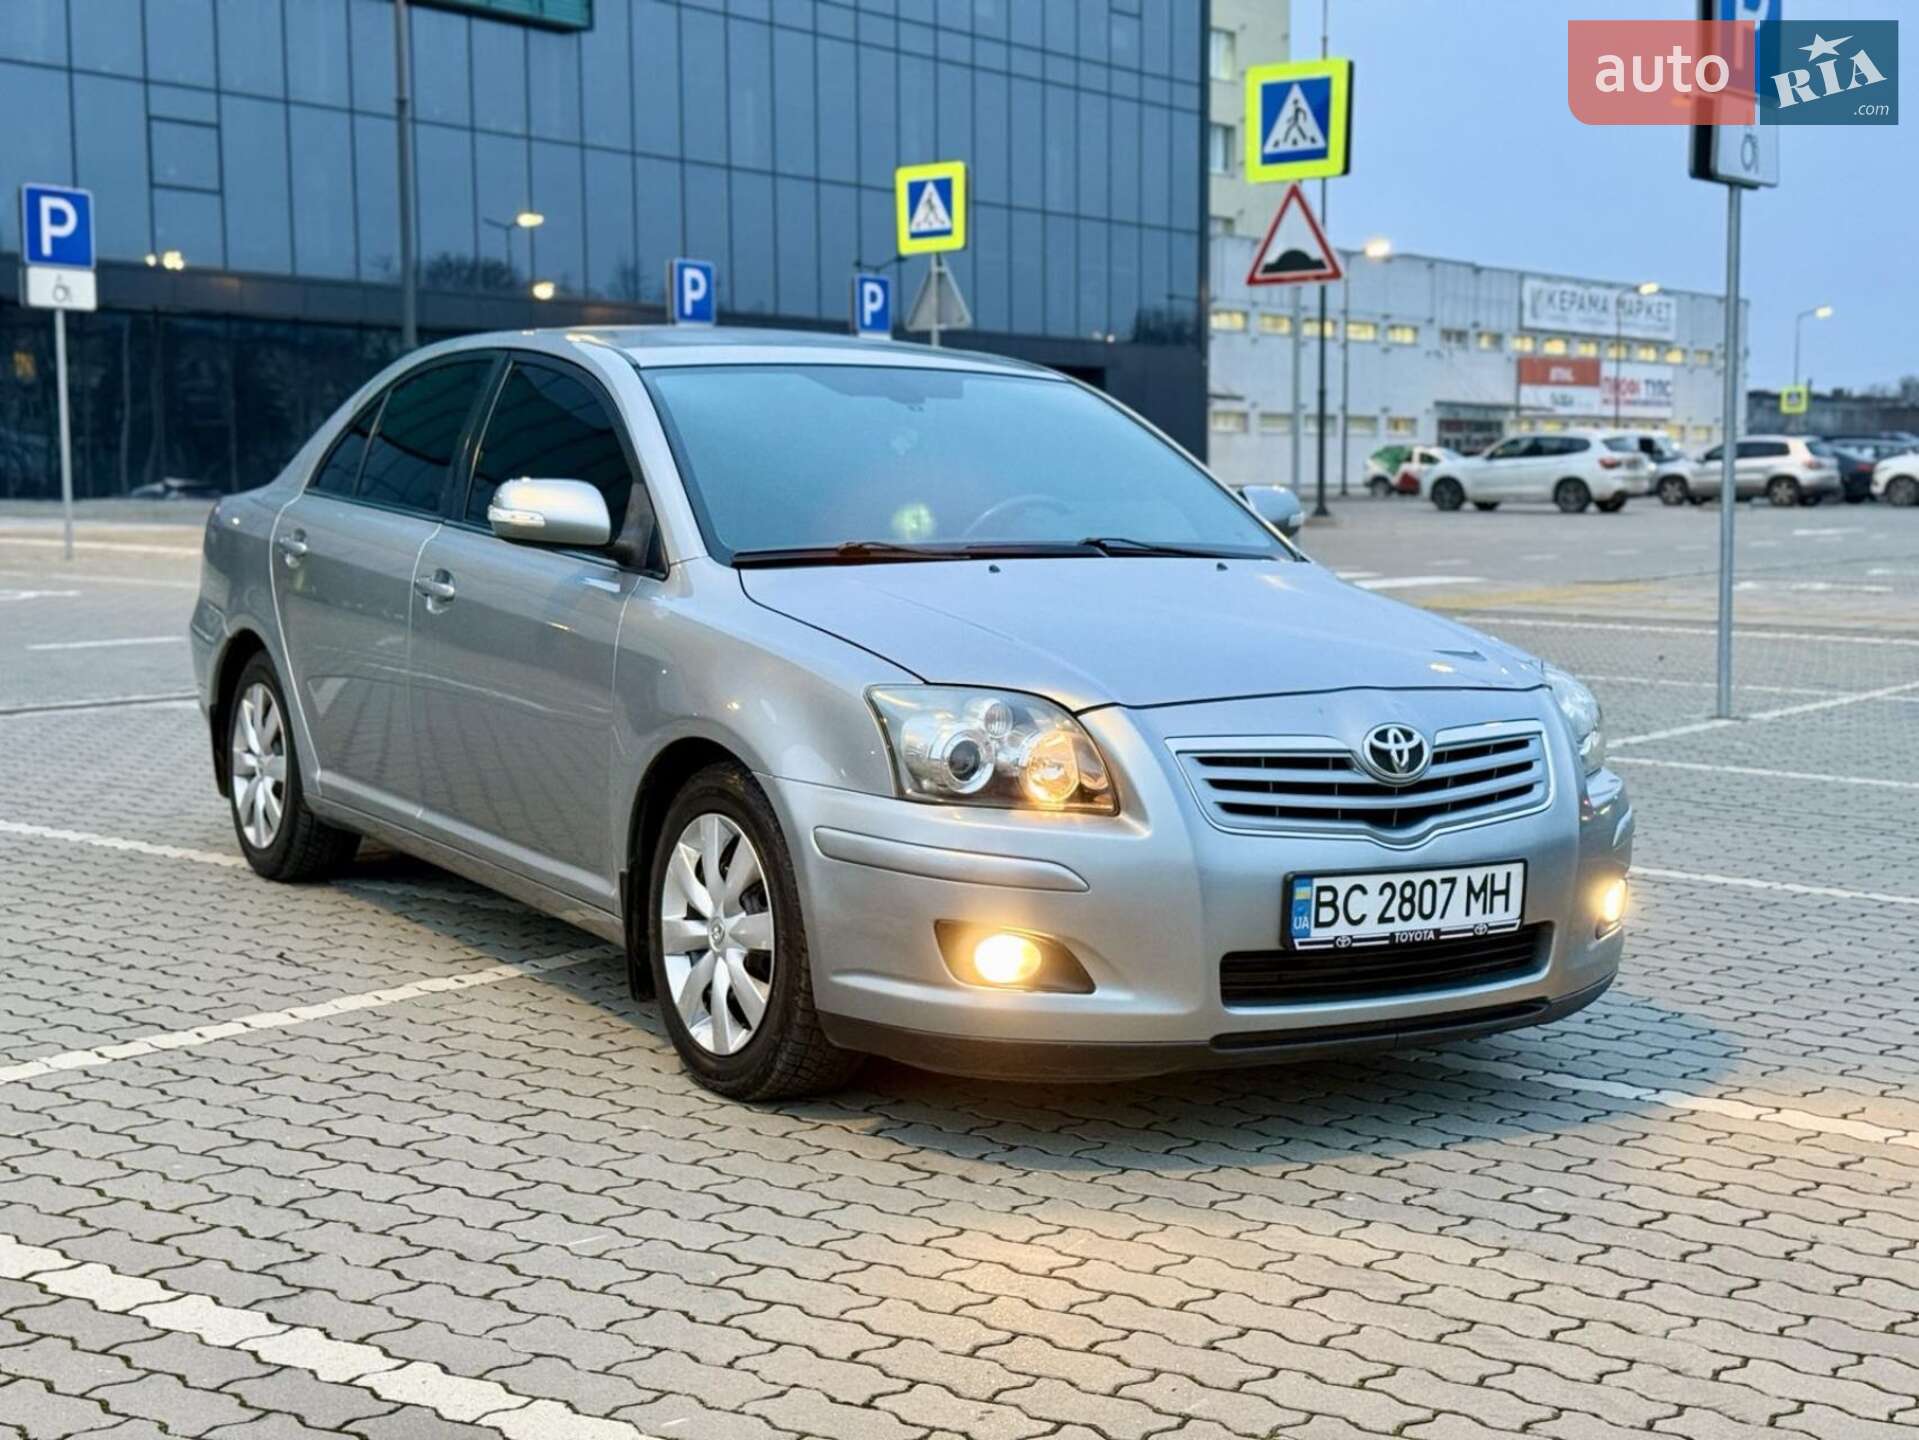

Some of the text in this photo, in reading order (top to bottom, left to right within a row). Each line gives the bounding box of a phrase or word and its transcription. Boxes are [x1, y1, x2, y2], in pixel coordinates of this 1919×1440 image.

[39, 195, 78, 257] P
[683, 267, 707, 316] P
[863, 281, 885, 326] P
[1313, 871, 1512, 928] BC 2807 MH
[1293, 917, 1310, 931] UA
[1395, 929, 1436, 944] TOYOTA
